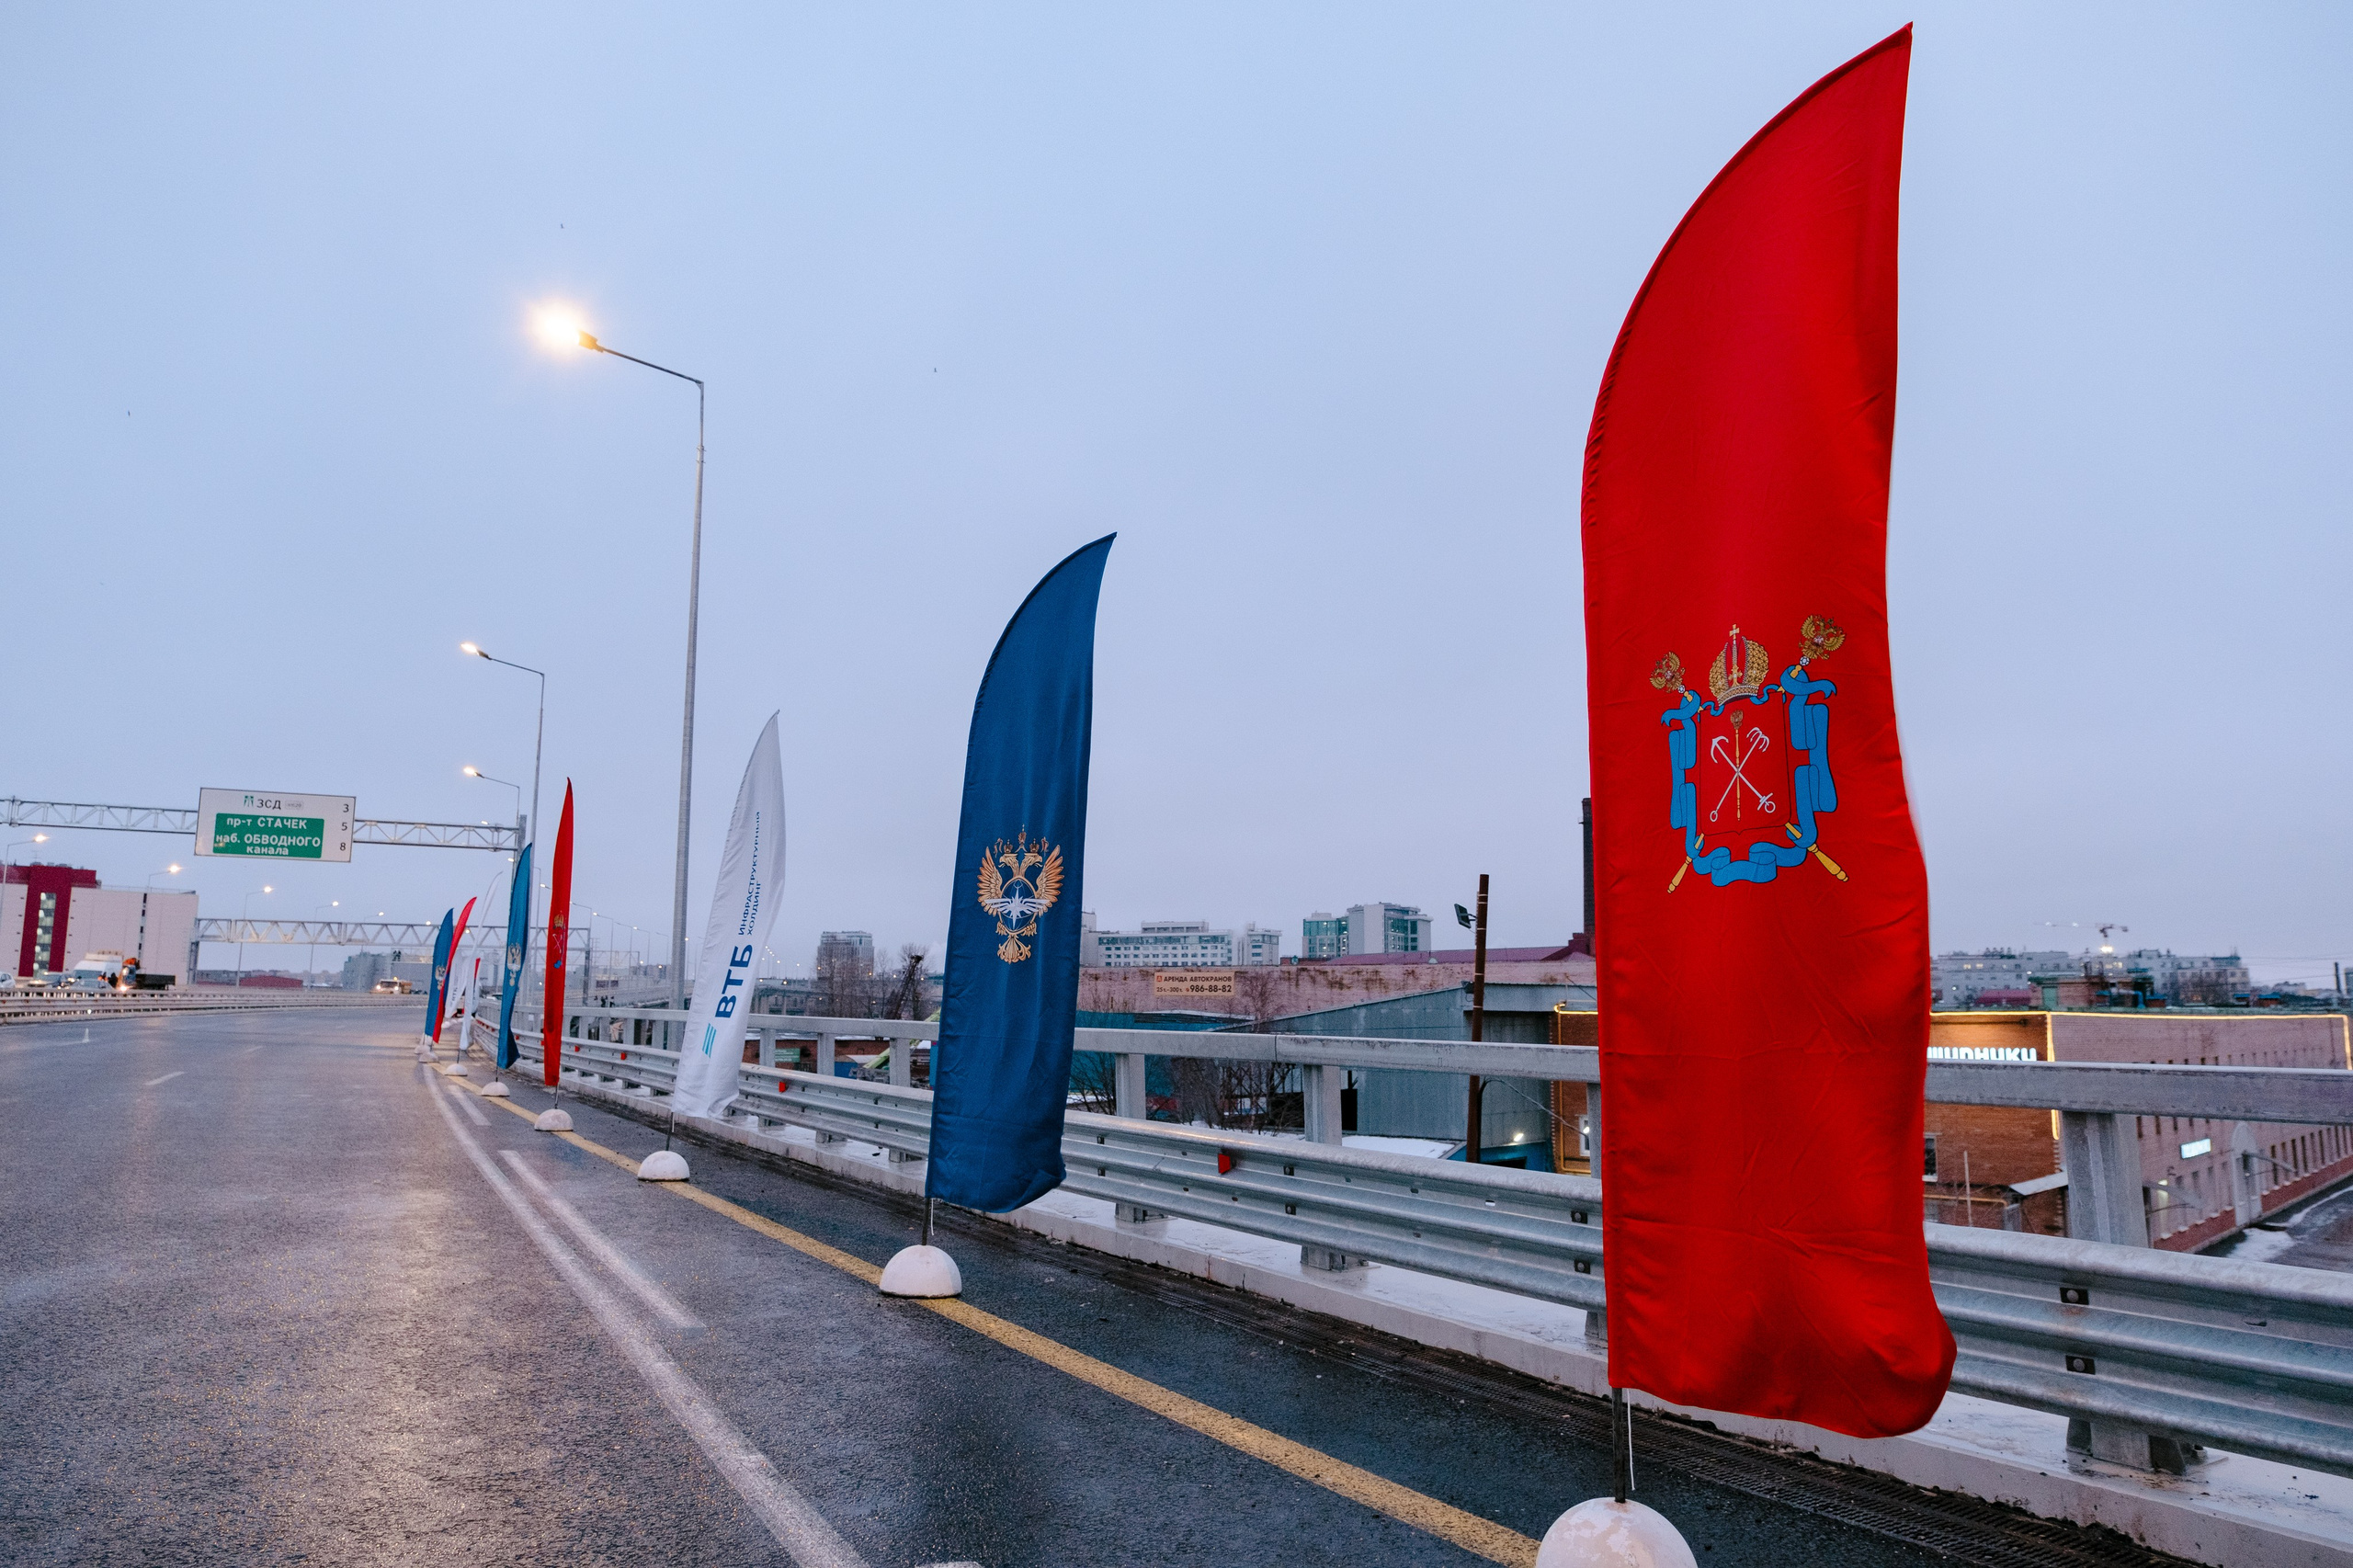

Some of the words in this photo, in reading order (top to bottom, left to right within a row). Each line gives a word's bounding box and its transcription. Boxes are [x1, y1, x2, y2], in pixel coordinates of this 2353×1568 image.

[256, 799, 281, 810] ЗСД
[343, 803, 349, 812] 3
[226, 817, 252, 828] пр-т
[257, 817, 307, 829] СТАЧЕК
[341, 823, 347, 831] 5
[215, 833, 241, 844] наб.
[244, 834, 321, 847] ОБВОДНОГО
[246, 846, 289, 856] канала
[339, 843, 346, 851] 8
[747, 881, 761, 936] ХОЛДИНГ
[715, 944, 753, 1018] ВТБ
[1189, 984, 1232, 993] 986-88-82
